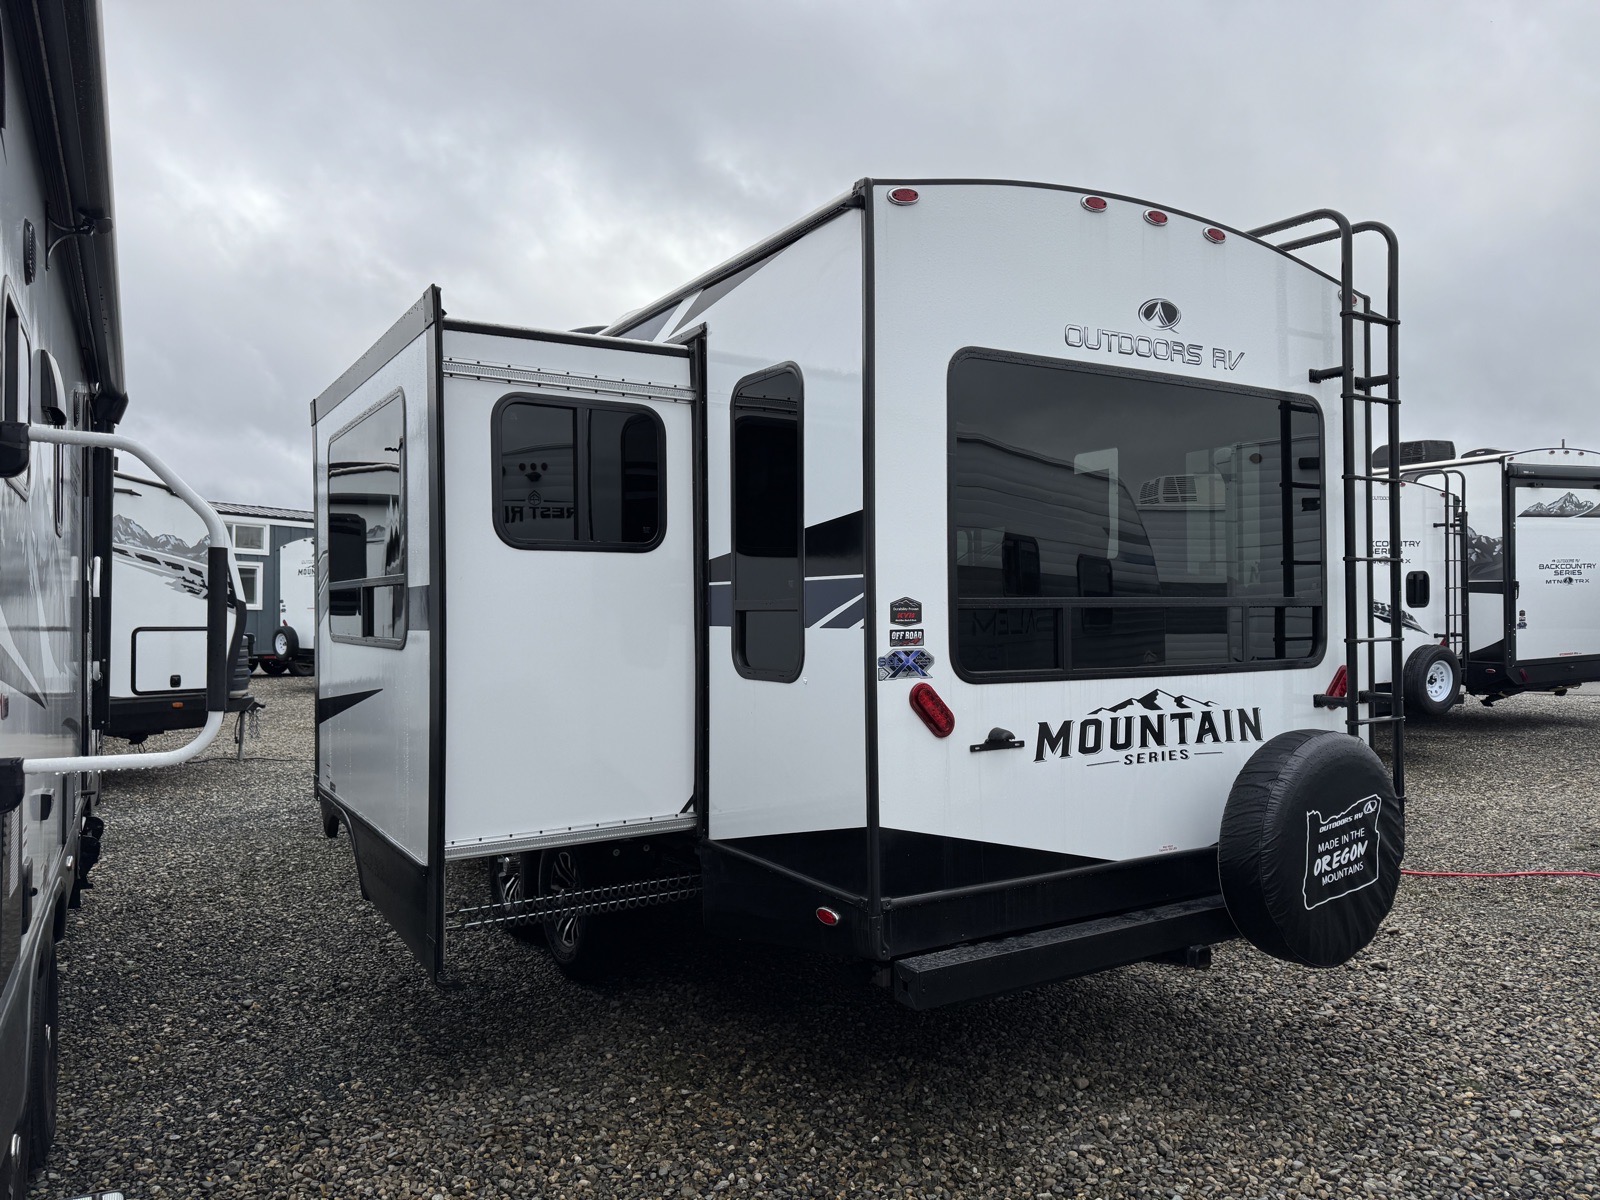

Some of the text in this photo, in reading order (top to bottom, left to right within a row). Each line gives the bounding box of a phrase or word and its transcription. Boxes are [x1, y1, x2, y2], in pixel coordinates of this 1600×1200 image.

[1064, 324, 1245, 371] OUTDOORS RV
[891, 631, 923, 640] OFF ROAD
[1033, 707, 1266, 763] MOUNTAIN
[1123, 749, 1190, 766] SERIES
[1319, 812, 1364, 833] OUTDOORS RV
[1318, 827, 1365, 854] MADE IN THE
[1313, 839, 1369, 877] OREGON
[1321, 861, 1364, 887] MOUNTAINS
